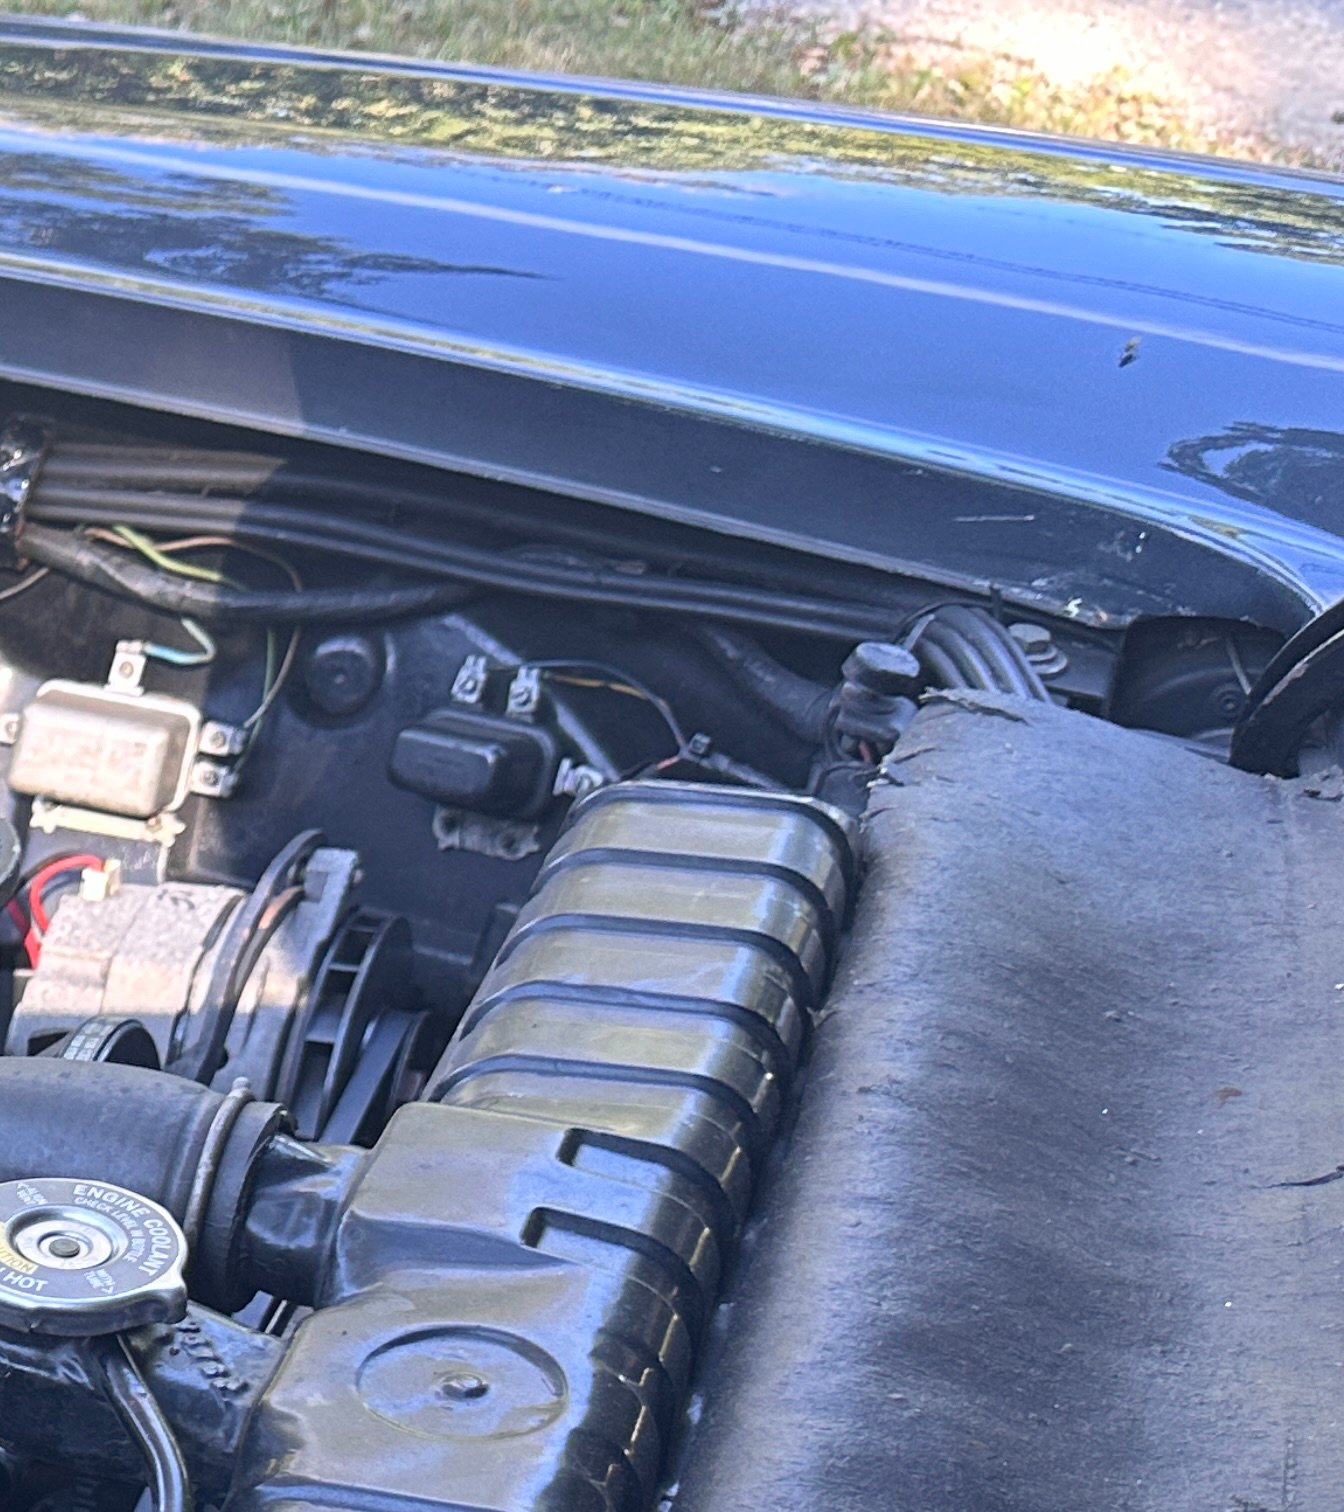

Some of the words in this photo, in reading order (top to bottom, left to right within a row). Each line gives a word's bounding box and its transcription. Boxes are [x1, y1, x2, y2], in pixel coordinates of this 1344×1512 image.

[74, 1196, 115, 1213] CHECK
[73, 1184, 150, 1217] ENGINE
[143, 1218, 172, 1277] COOLANT
[3, 1271, 48, 1292] HOT
